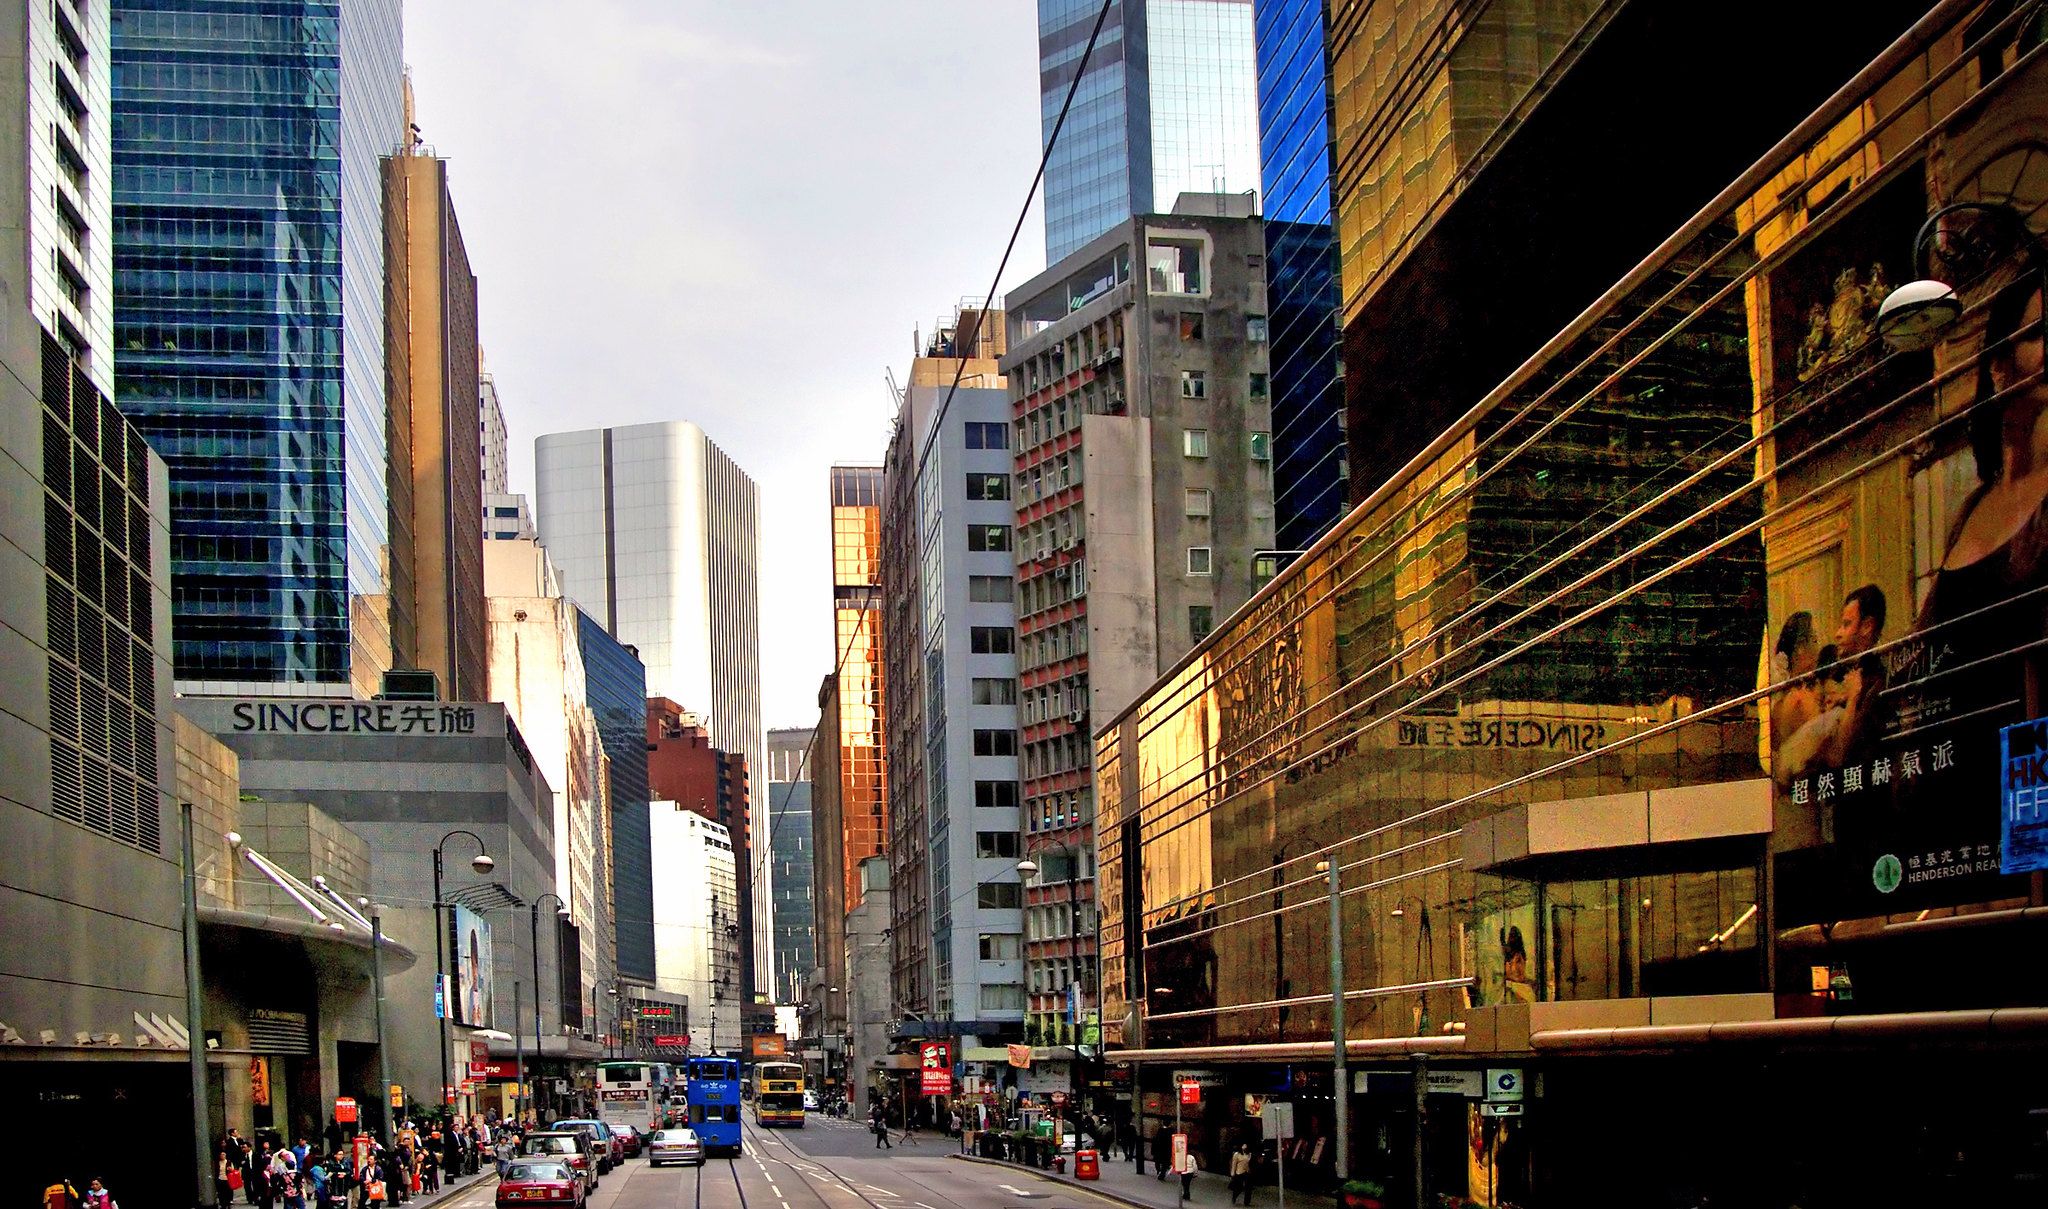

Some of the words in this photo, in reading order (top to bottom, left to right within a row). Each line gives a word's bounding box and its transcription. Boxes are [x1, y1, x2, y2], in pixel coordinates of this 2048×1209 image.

[233, 703, 397, 732] SINCERE
[400, 705, 475, 734] 先施
[1792, 740, 1955, 805] 超然顯赫氣派
[2010, 752, 2048, 789] HK
[1908, 863, 1973, 883] HENDERSON
